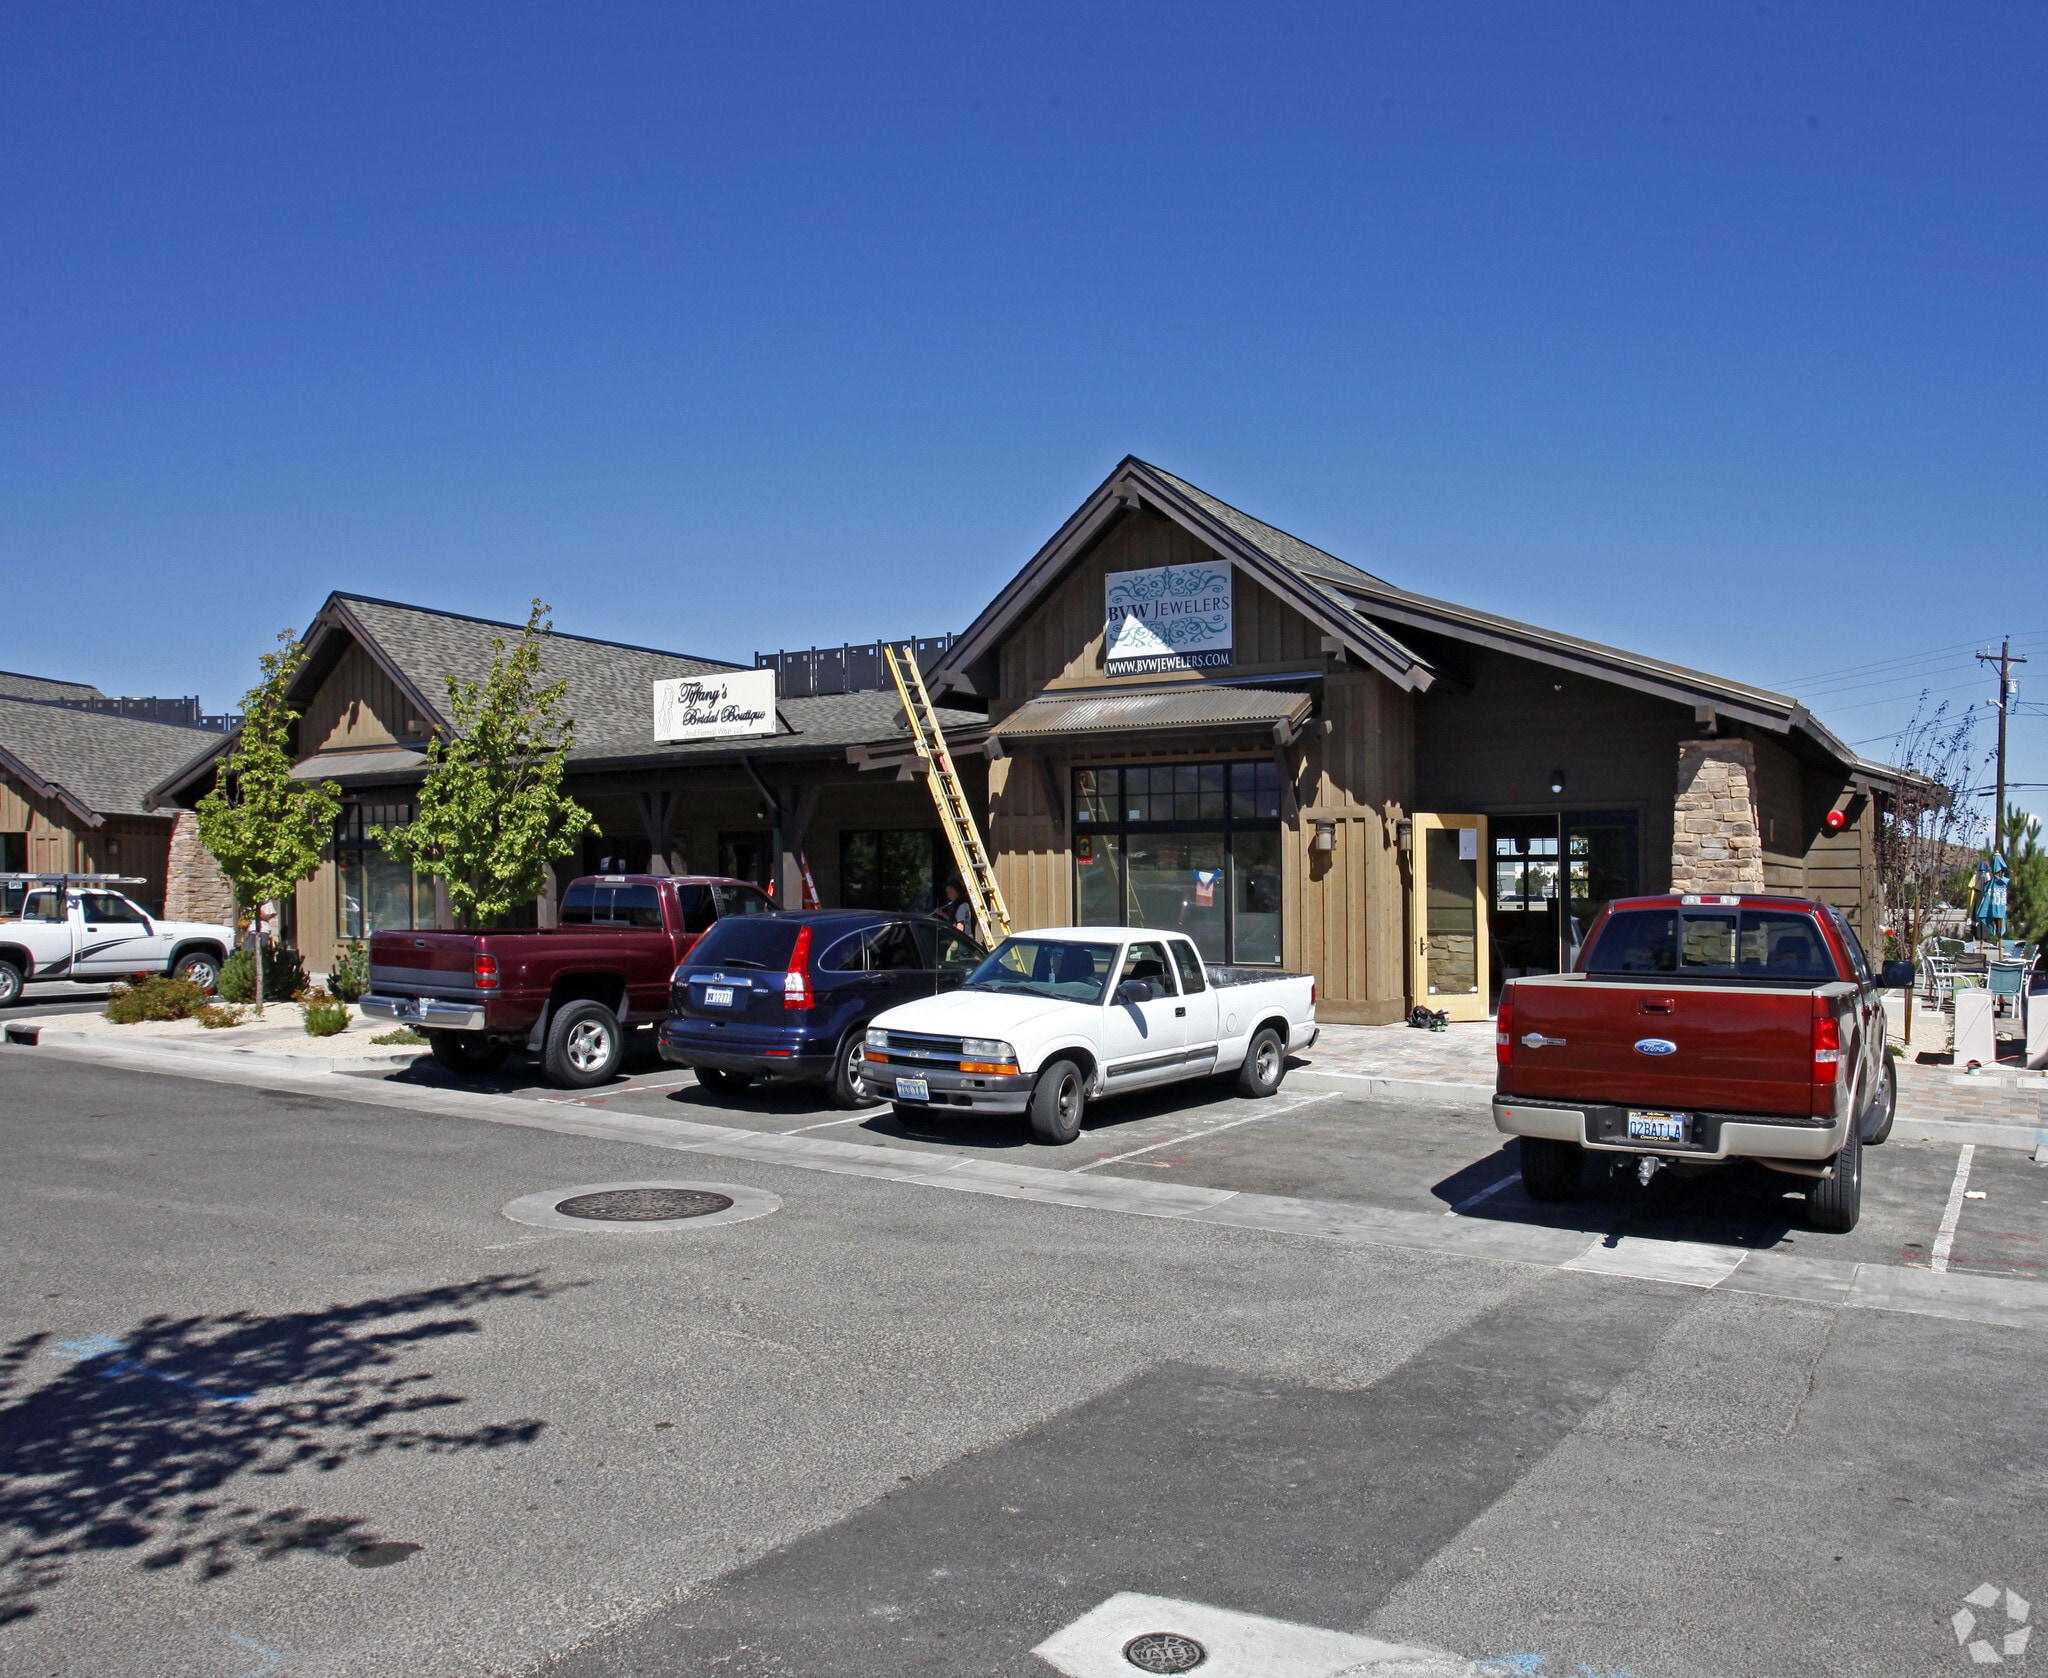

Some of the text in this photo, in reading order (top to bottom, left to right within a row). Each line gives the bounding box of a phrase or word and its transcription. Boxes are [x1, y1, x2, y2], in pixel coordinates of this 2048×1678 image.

[1108, 596, 1230, 621] BVW JEWELERS
[1108, 653, 1230, 674] WWW.BVWJEWELERS.COM
[678, 682, 728, 709] Tiffany's
[682, 705, 766, 727] Bridal Boutique
[684, 729, 696, 737] And
[697, 727, 717, 736] Formal
[717, 727, 732, 735] Wear
[1643, 1042, 1666, 1053] Ford
[1134, 1646, 1197, 1659] WATER
